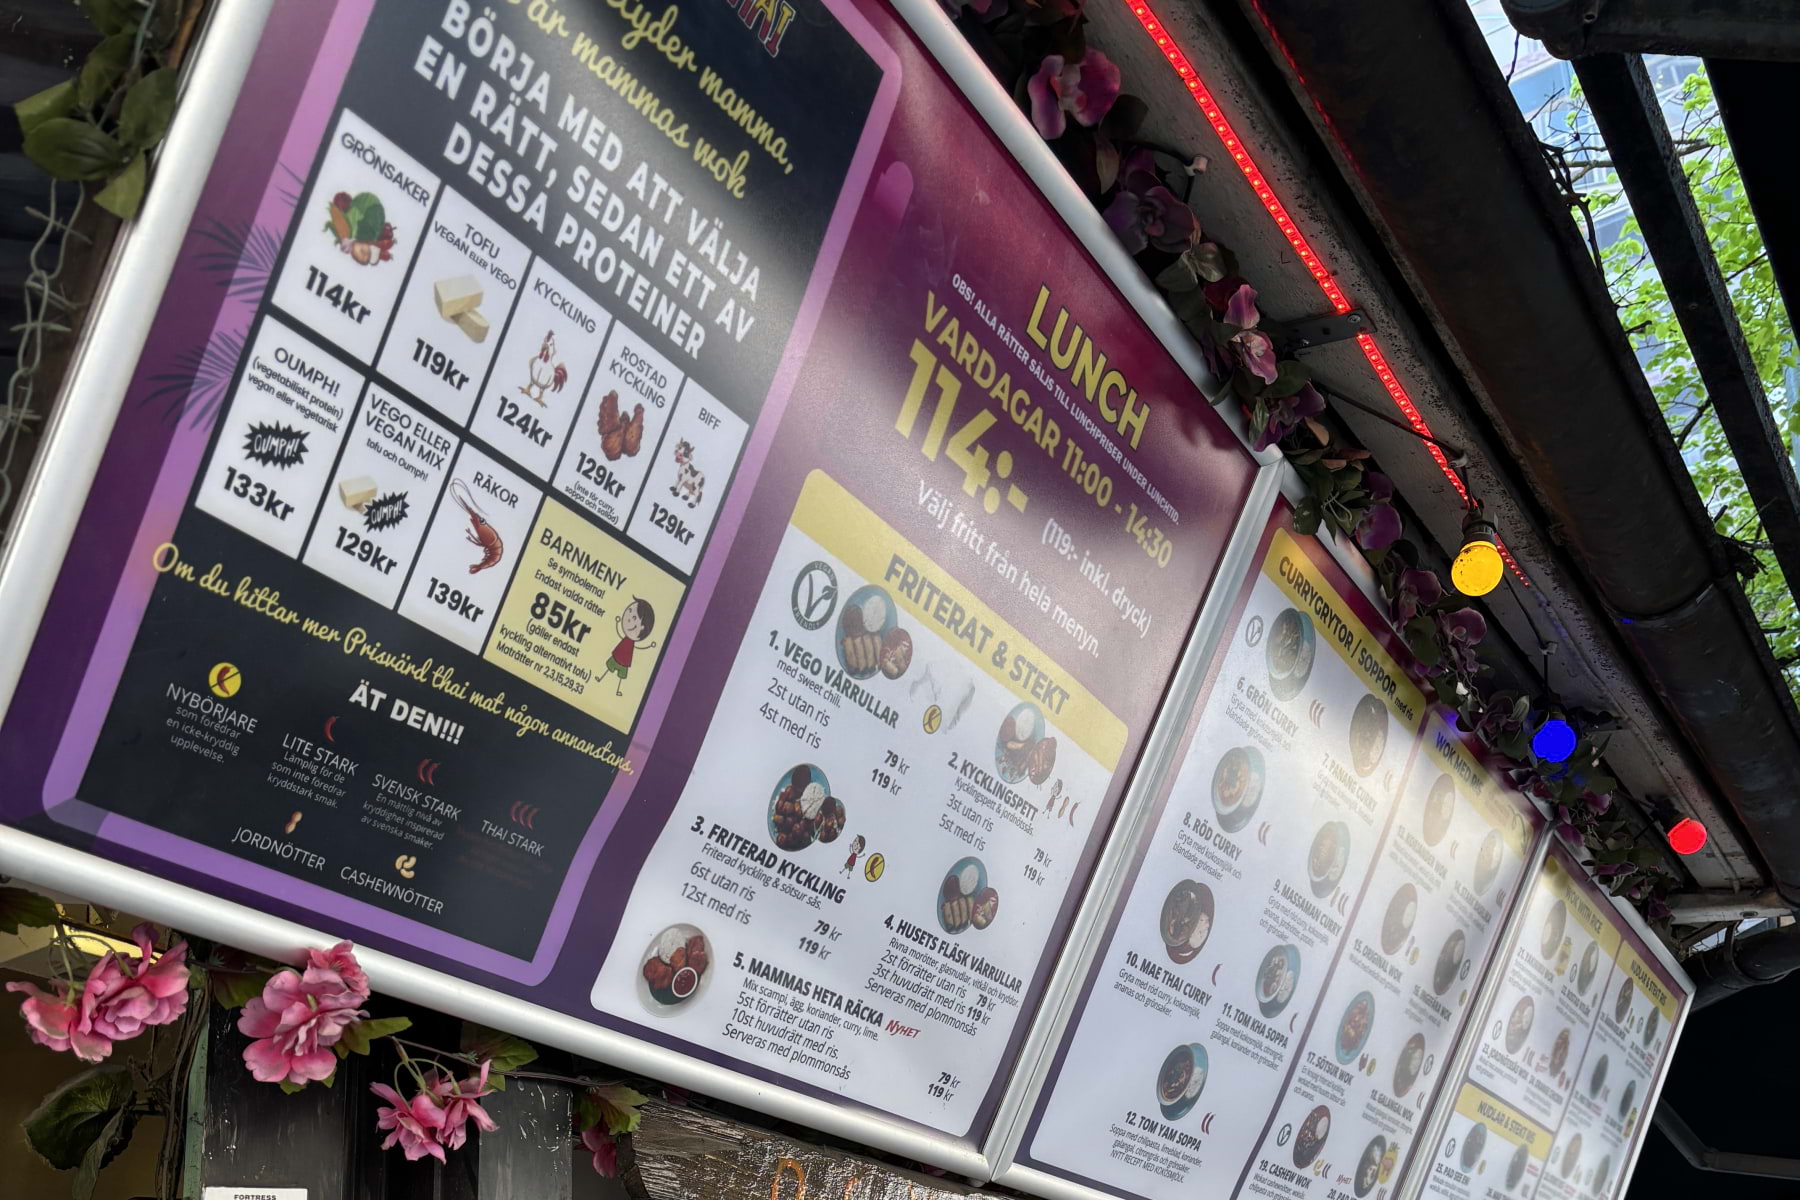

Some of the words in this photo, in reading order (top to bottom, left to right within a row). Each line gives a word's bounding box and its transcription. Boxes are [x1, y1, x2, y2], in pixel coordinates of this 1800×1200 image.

[572, 32, 689, 149] mammas
[693, 137, 749, 199] wok
[606, 0, 697, 72] tyder
[700, 66, 793, 175] mamma,
[340, 131, 431, 207] GRÖNSAKER
[441, 0, 550, 113] BÖRJA
[557, 94, 623, 172] MED
[626, 162, 685, 225] ATT
[687, 207, 761, 303] VÄLJA
[414, 35, 467, 100] EN
[469, 80, 557, 188] RÄTT,
[567, 165, 664, 268] SEDAN
[665, 250, 716, 310] ETT
[716, 300, 755, 343] AV
[443, 123, 548, 234] DESSA
[555, 213, 705, 360] PROTEINER
[465, 224, 500, 260] TOFU
[304, 266, 372, 326] 114kr
[533, 278, 597, 334] KYCKLING
[274, 347, 340, 397] OUMPH!
[411, 337, 470, 391] 119kr
[609, 361, 666, 409] KYCKLING
[620, 346, 667, 389] ROSTAD
[1026, 282, 1151, 451] LUNCH
[371, 394, 410, 428] VEGO
[413, 424, 451, 455] ELLER
[495, 395, 553, 449] 124kr
[697, 407, 721, 431] BIFF
[895, 338, 1029, 514] 114:-
[952, 273, 976, 306] OBS!
[974, 299, 997, 330] ALLA
[996, 324, 1029, 365] RÄTTER
[1028, 358, 1055, 392] SÄLJS
[1053, 384, 1071, 410] TILL
[1070, 402, 1123, 464] LUNCHPRISER
[1122, 457, 1147, 489] UNDER
[1147, 486, 1180, 526] LUNCHTID.
[365, 411, 415, 453] VEGAN
[417, 445, 445, 471] MIX
[924, 289, 1061, 458] VARDAGAR
[1061, 438, 1113, 507] 11:00
[1124, 503, 1173, 569] 14:30
[366, 438, 382, 454] tofu
[382, 447, 397, 463] och
[398, 459, 428, 482] Oumph!
[574, 452, 626, 500] 129kr
[223, 466, 294, 522] 133kr
[472, 471, 519, 509] RÄKOR
[334, 526, 398, 576] 129kr
[649, 503, 694, 546] 129kr
[540, 528, 627, 591] BARNMENY
[917, 480, 953, 530] Välj
[950, 512, 985, 555] fritt
[985, 542, 1019, 584] från
[1018, 570, 1051, 614] hela
[1052, 603, 1100, 658] menyn.
[426, 577, 484, 623] 139kr
[530, 592, 591, 644] 85kr
[1079, 550, 1110, 596] inkl.
[1111, 585, 1152, 639] dryck)
[153, 542, 195, 582] Om
[199, 563, 230, 597] du
[233, 576, 300, 624] hittar
[301, 616, 342, 644] mer
[343, 627, 427, 683] Prisvärd
[428, 666, 469, 700] thai
[468, 692, 505, 715] mat
[504, 704, 550, 738] någon
[884, 553, 995, 655] FRITERAT
[991, 640, 1009, 670] &
[1009, 654, 1070, 715] STEKT
[1278, 556, 1354, 652] CURRYGRYTOR
[1358, 648, 1397, 699] SOPPOR
[165, 682, 259, 734] NYBÖRJARE
[783, 638, 823, 677] VEGO
[824, 665, 899, 729] VÅRRULLAR
[349, 679, 387, 713] ÄT
[390, 698, 465, 745] DEN!!!
[282, 732, 314, 757] LITE
[313, 747, 360, 776] STARK
[372, 773, 421, 805] SVENSK
[421, 796, 462, 822] STARK
[960, 759, 1039, 821] KYCKLINGSPETT
[231, 827, 326, 871] JORDNÖTTER
[481, 820, 509, 841] THAI
[507, 833, 545, 857] STARK
[707, 823, 778, 869] FRITERAD
[777, 859, 847, 904] KYCKLING
[1192, 818, 1213, 841] RÖD
[1212, 832, 1243, 862] CURRY
[339, 865, 444, 915] CASHEWNÖTTER
[690, 861, 711, 881] 6st
[710, 872, 740, 895] utan
[741, 883, 756, 902] ris
[799, 936, 820, 955] 119
[818, 945, 832, 961] kr
[813, 919, 830, 936] 79
[828, 926, 842, 942] kr
[895, 919, 939, 951] HUSETS
[937, 940, 970, 967] FLÄSK
[969, 955, 1023, 994] VÅRRULLAR
[748, 958, 812, 997] MAMMAS
[811, 984, 844, 1011] HETA
[843, 999, 884, 1028] RÄCKA
[1140, 958, 1162, 981] MAE
[1163, 969, 1183, 992] THAI
[1182, 982, 1213, 1008] CURRY
[722, 1023, 766, 1049] Serveras
[767, 1042, 791, 1058] med
[790, 1049, 852, 1080] plommonsås
[1233, 1008, 1251, 1027] TOM
[1250, 1016, 1266, 1035] KHA
[1265, 1026, 1289, 1049] SOPPA
[1138, 1116, 1159, 1134] TOM
[1158, 1123, 1177, 1143] YAM
[1176, 1132, 1202, 1152] SOPPA
